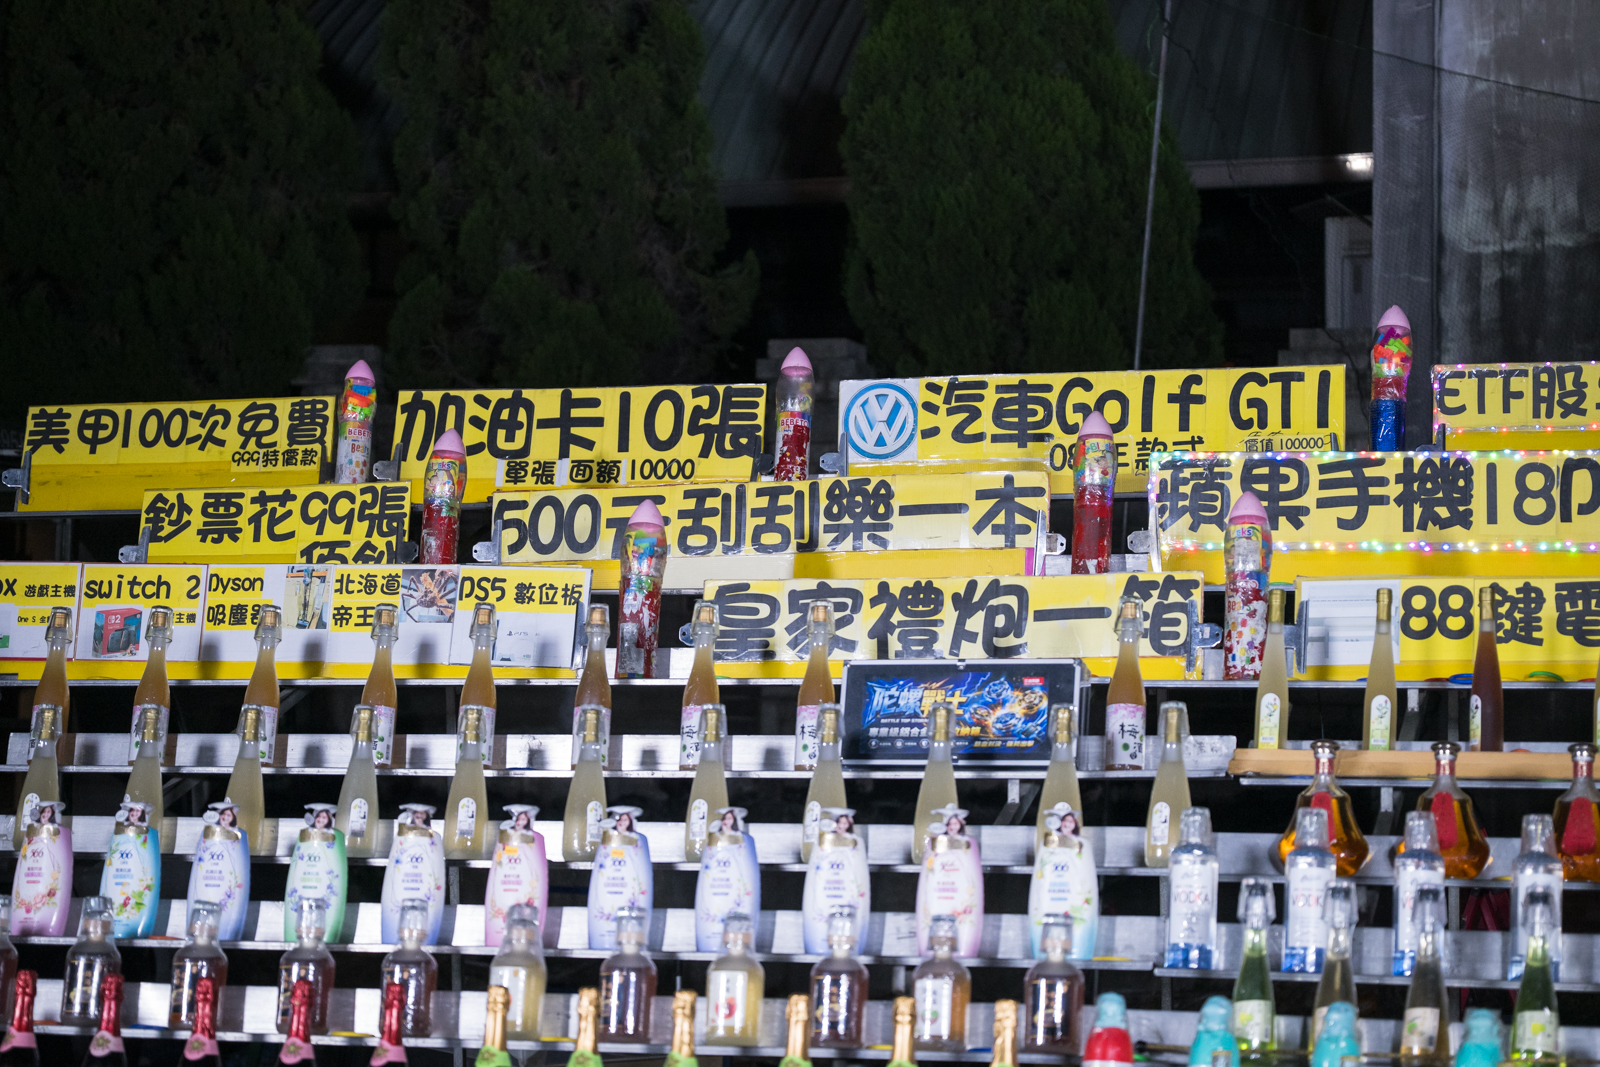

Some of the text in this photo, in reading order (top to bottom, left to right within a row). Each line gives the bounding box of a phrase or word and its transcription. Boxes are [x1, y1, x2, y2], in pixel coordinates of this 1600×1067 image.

[1229, 371, 1331, 431] GTI
[1441, 365, 1600, 419] ETF股
[27, 398, 329, 454] 美甲100次免費
[400, 386, 764, 461] 加油卡10張
[781, 418, 809, 427] BEBETO
[1280, 437, 1324, 450] 100000
[231, 449, 318, 468] 999特價款
[505, 459, 695, 485] 單張 面額 10000
[143, 485, 409, 544] 鈔票花99張
[498, 474, 1045, 559] 500元刮刮樂一本
[24, 584, 76, 598] 遊戲主機
[83, 574, 201, 599] switch 2
[208, 573, 264, 595] Dyson
[334, 573, 402, 595] 北海道
[459, 576, 508, 602] PS5
[513, 582, 583, 606] 數位板
[17, 615, 29, 623] One
[171, 611, 196, 624] 主機
[711, 574, 1201, 660] 皇家禮炮一箱
[1173, 890, 1210, 904] VODKA
